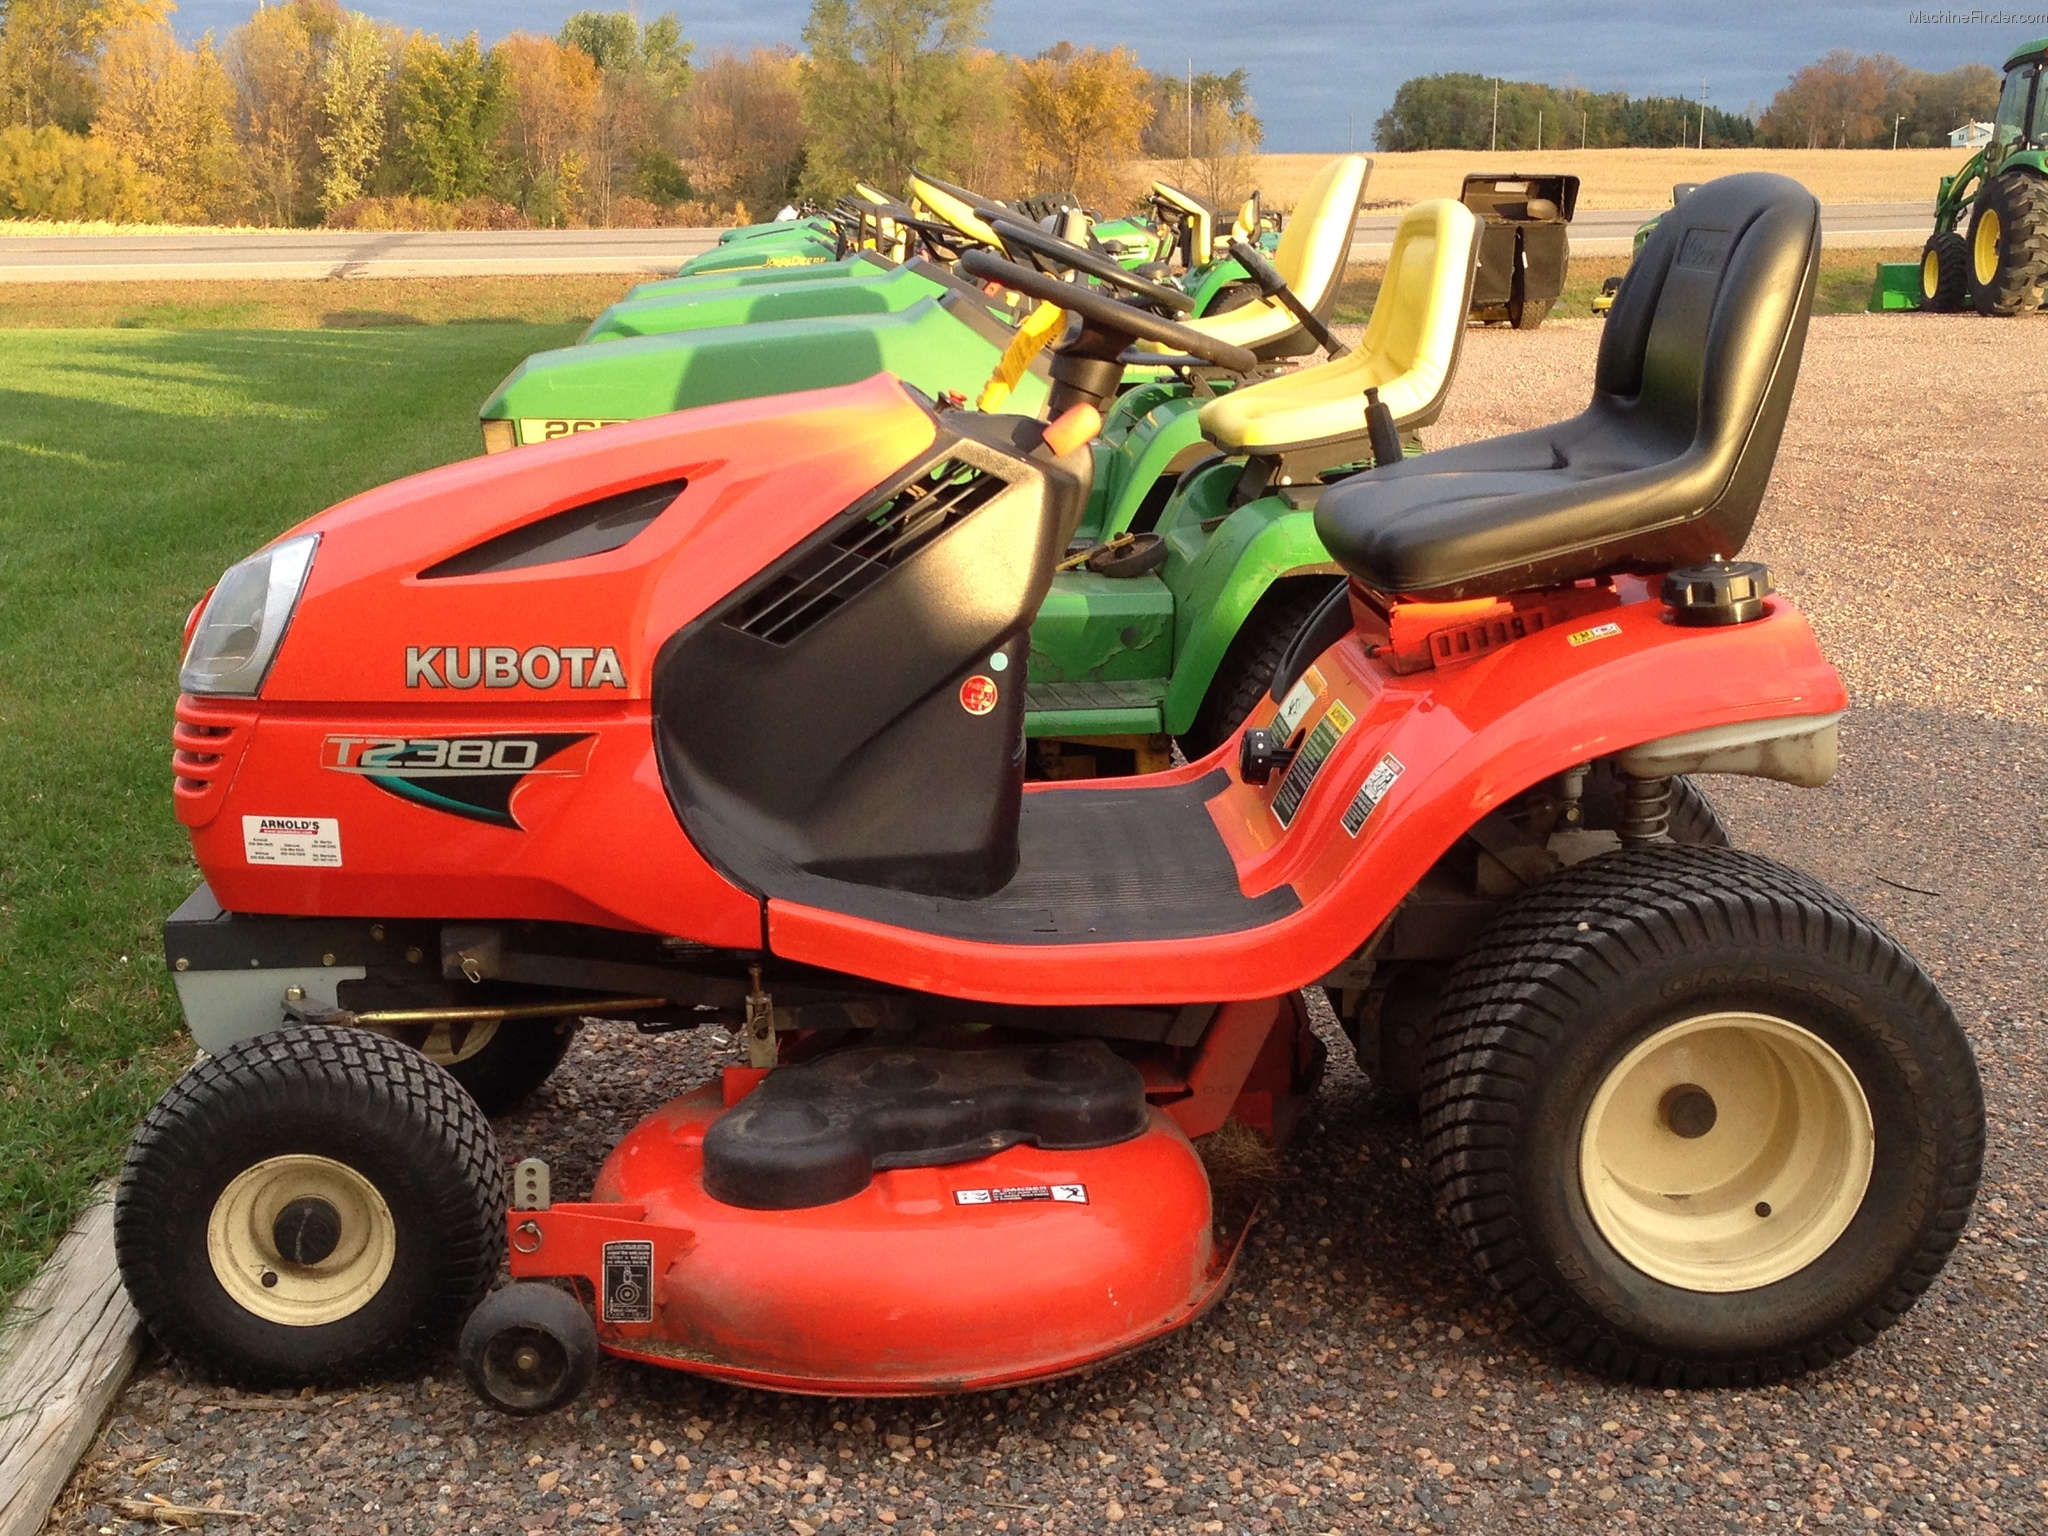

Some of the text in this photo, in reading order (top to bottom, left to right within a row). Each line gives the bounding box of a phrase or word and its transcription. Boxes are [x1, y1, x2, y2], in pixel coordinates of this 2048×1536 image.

[405, 645, 628, 690] KUBOTA
[327, 738, 539, 769] T2380
[260, 819, 320, 830] ARNOLD'S
